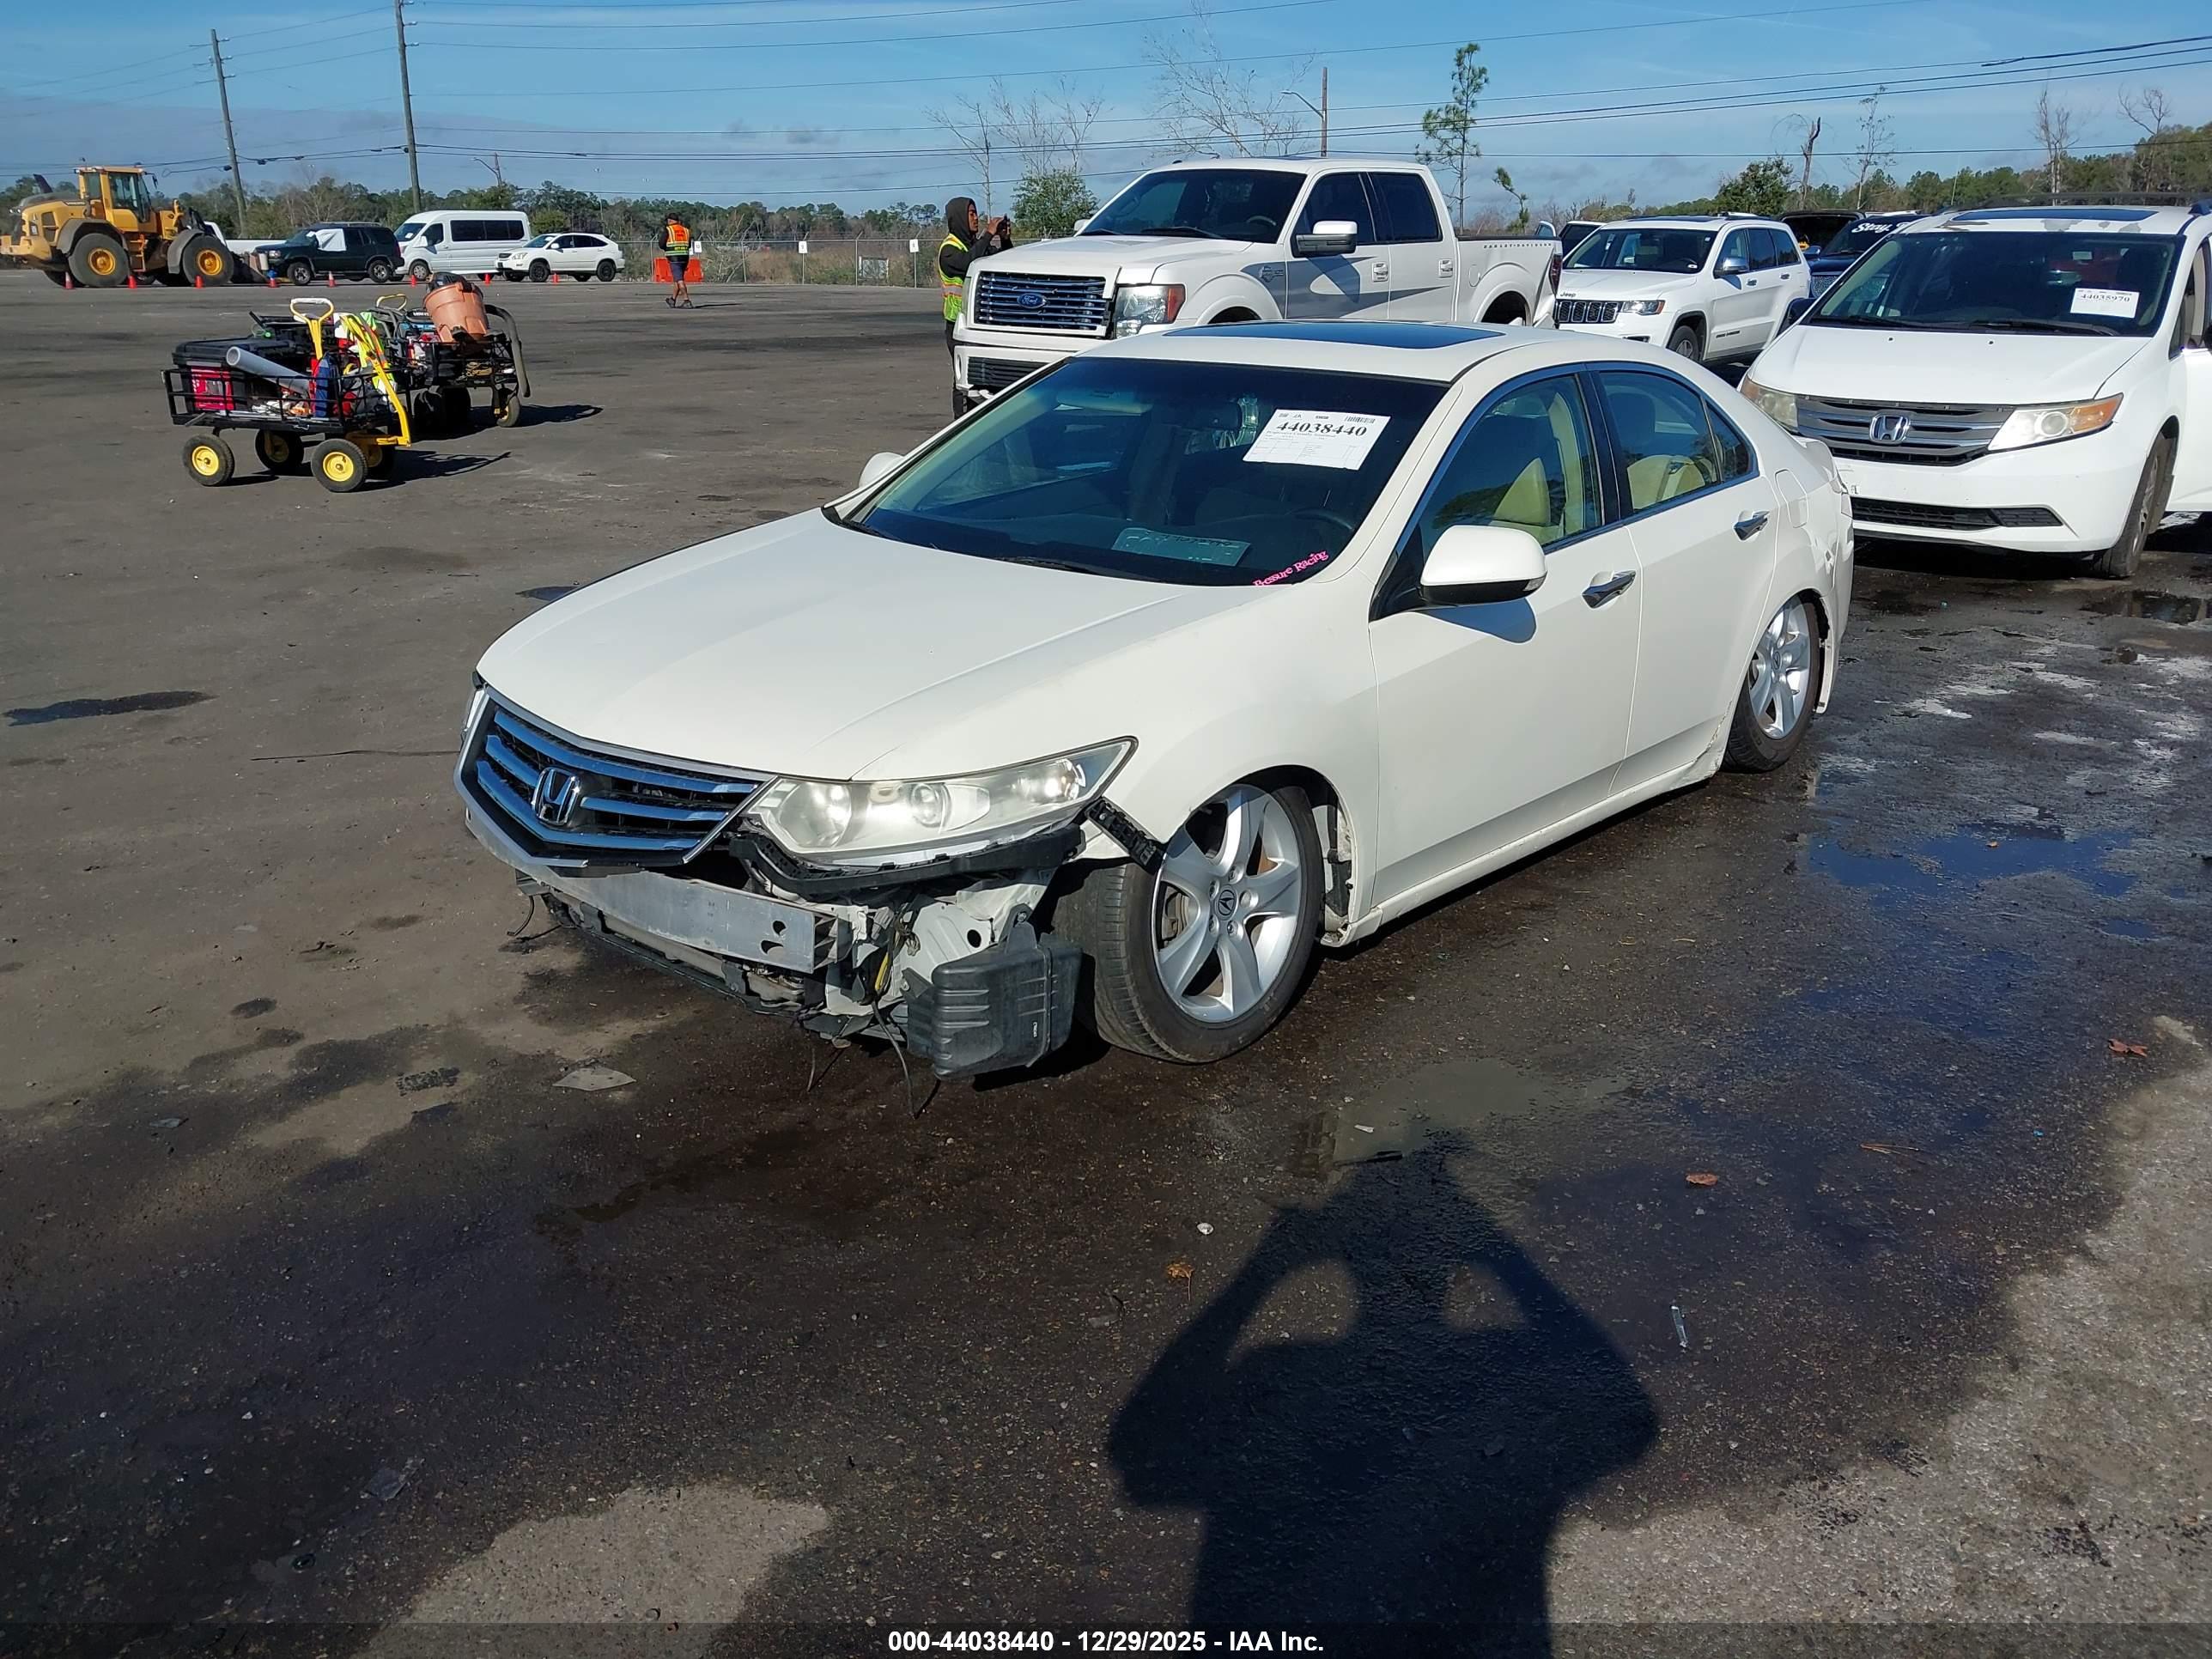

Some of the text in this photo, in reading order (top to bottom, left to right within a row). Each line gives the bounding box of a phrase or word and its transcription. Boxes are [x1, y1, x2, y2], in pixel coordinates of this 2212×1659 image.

[2081, 294, 2130, 302] 44035970
[1276, 422, 1368, 436] 44038440
[1253, 550, 1328, 587] Pressure Racing
